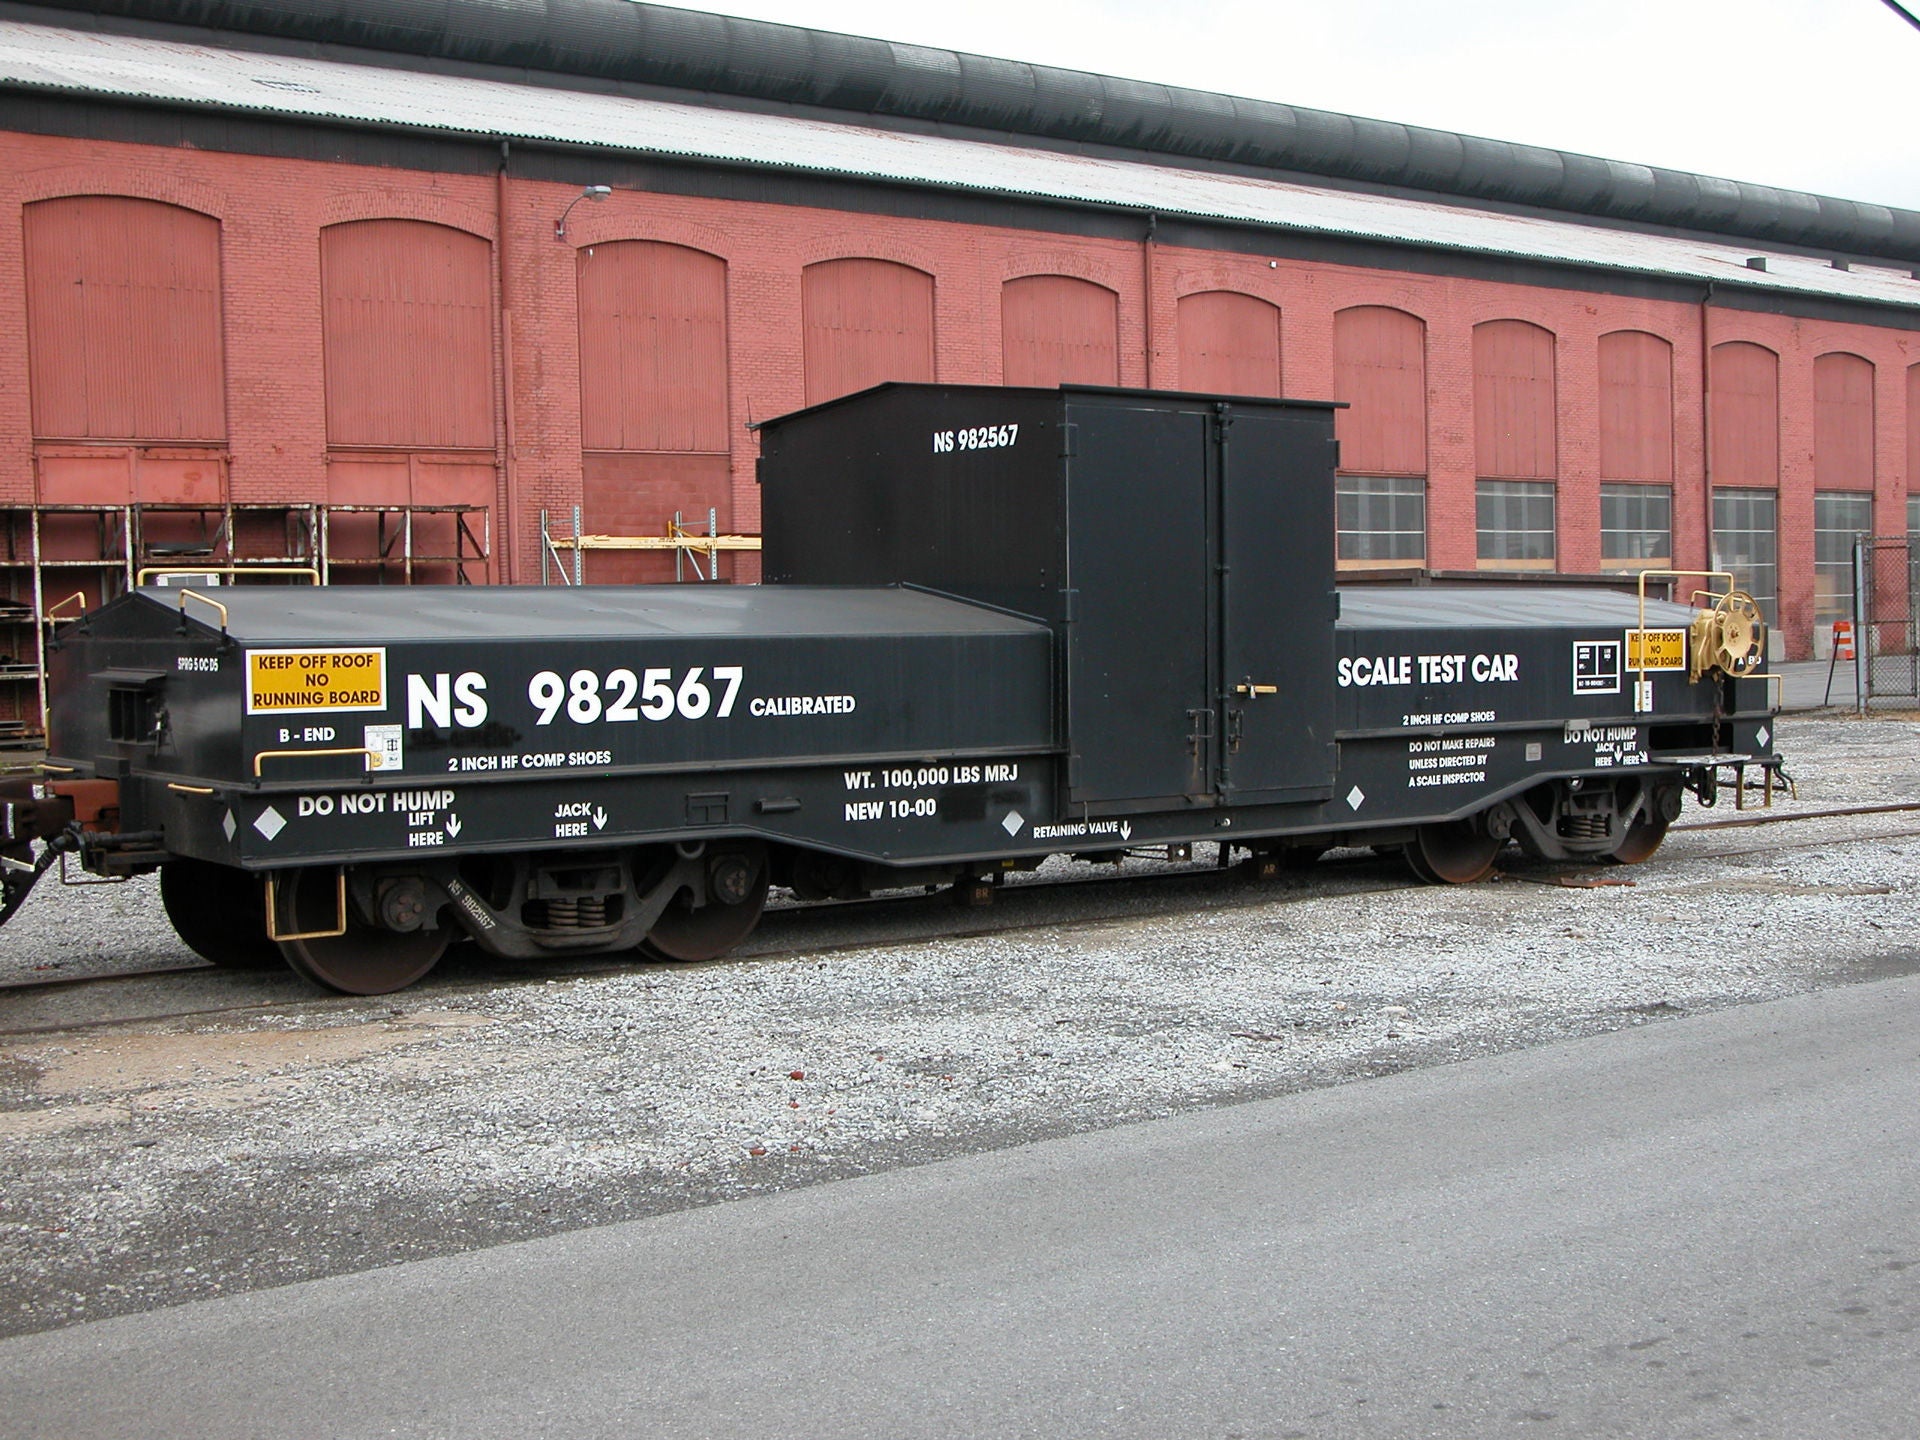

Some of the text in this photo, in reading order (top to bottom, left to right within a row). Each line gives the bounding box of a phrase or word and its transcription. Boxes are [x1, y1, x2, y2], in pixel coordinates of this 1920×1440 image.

[933, 424, 1019, 453] NS 982567
[1648, 633, 1660, 642] OFF
[1662, 633, 1680, 642] ROOF
[1650, 645, 1661, 655] NO
[194, 657, 198, 671] 5
[259, 654, 373, 669] KEEP OFF ROOF
[1661, 657, 1683, 666] BOARD
[1737, 656, 1744, 665] A
[1337, 654, 1519, 687] SCALE TEST CAR
[305, 673, 329, 687] NO
[253, 690, 380, 706] RUNNING BOARD
[407, 666, 856, 729] NS 982567 CALIBRATED
[1403, 711, 1496, 726] 2 INCH HF COMP SHOES
[279, 729, 290, 743] B
[304, 727, 335, 742] END
[1564, 726, 1637, 744] DO NOT HUMP
[1409, 738, 1496, 753] DO NOT MAKE REPAIRS
[1595, 743, 1614, 753] JACK
[1623, 741, 1637, 751] LIFT
[448, 750, 612, 771] 2 INCH HF COMP SHOES
[1409, 754, 1488, 770] UNLESS DIRECTED BY
[1595, 756, 1613, 767] HERE
[1623, 755, 1640, 766] HERE
[844, 764, 1018, 790] WT. 100,000 LBS MRJ
[1408, 771, 1486, 788] A SCALE INSPECTOR
[298, 790, 455, 817] DO NOT HUMP
[554, 802, 592, 818] JACK
[845, 798, 936, 821] NEW 10-00
[408, 811, 435, 827] LIFT
[556, 822, 588, 838] HERE
[1033, 821, 1118, 839] RETAINING VALVE
[409, 831, 444, 847] HERE
